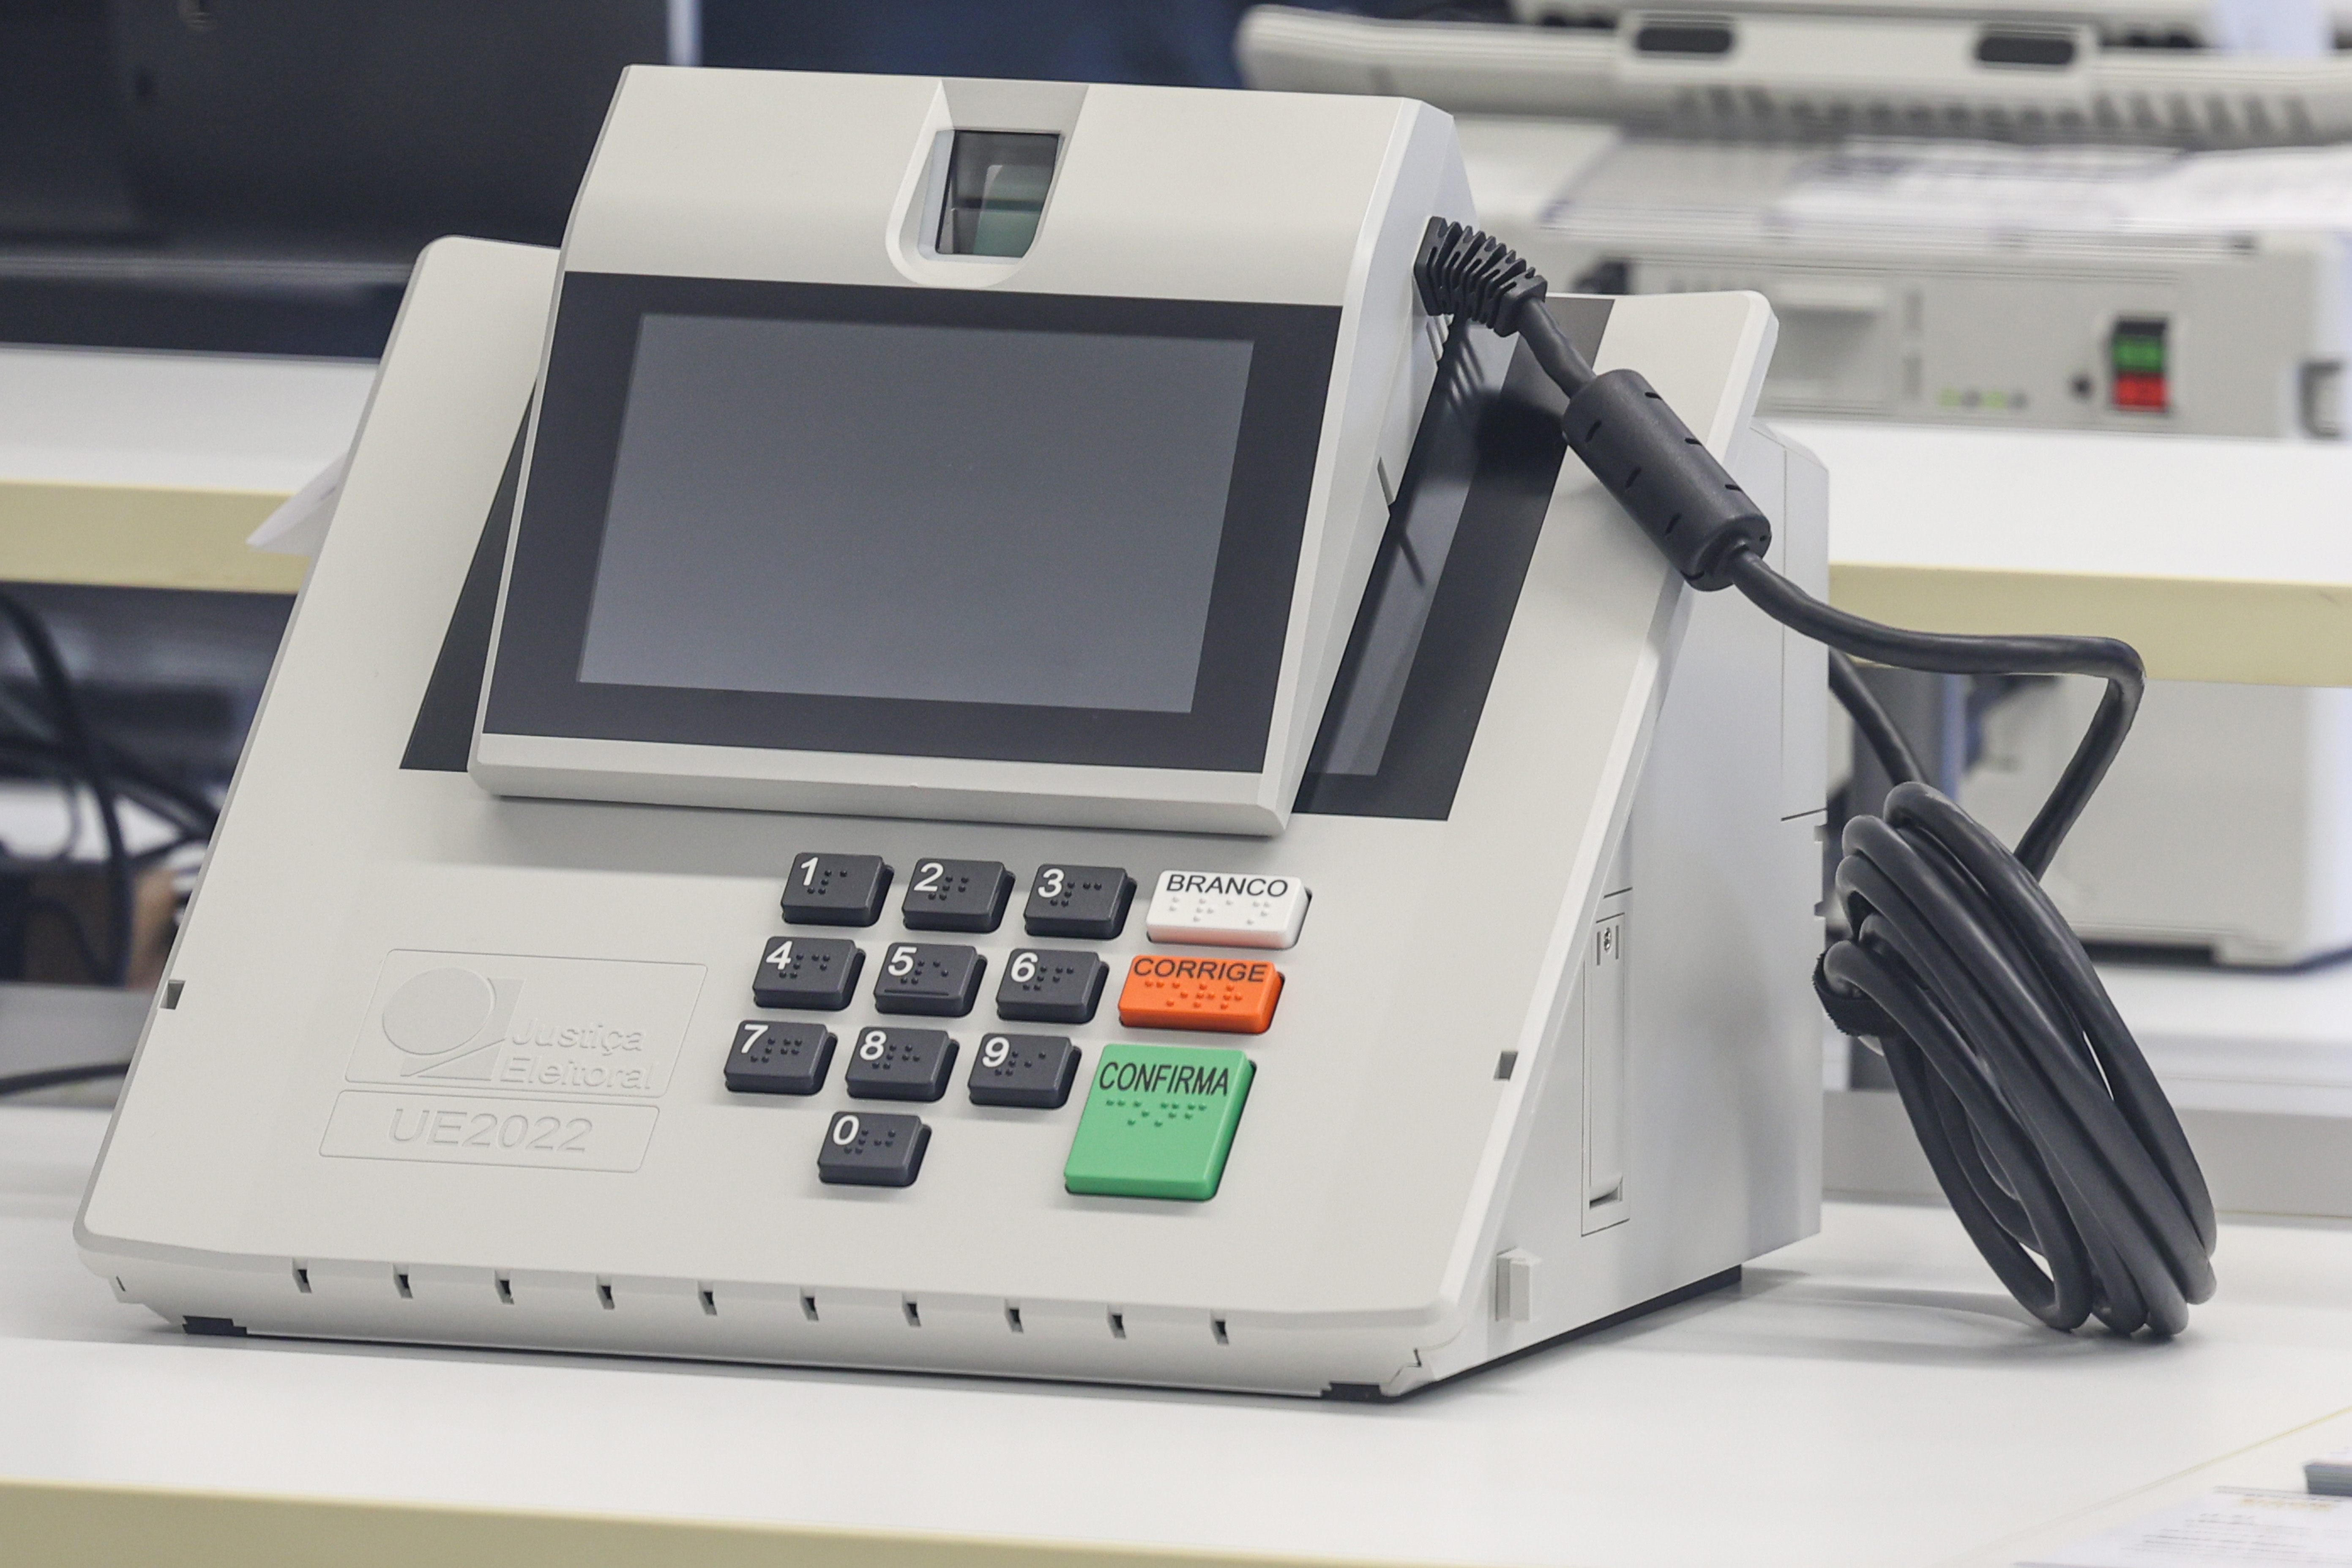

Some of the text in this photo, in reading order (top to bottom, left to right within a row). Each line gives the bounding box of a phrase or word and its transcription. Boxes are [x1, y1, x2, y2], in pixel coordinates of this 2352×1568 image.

[800, 856, 819, 886] 1
[913, 862, 944, 892] 2
[1037, 868, 1065, 899] 3
[1166, 873, 1289, 898] BRANCO
[765, 940, 793, 970] 4
[887, 945, 918, 977] 5
[1010, 951, 1039, 983] 6
[1133, 957, 1268, 983] CORRIGE
[511, 1018, 645, 1055] Justiça
[740, 1023, 769, 1054] 7
[859, 1030, 887, 1061] 8
[981, 1036, 1010, 1068] 9
[500, 1056, 659, 1089] Eleitoral
[1098, 1061, 1229, 1097] CONFIRMA
[388, 1108, 593, 1153] UE2022
[832, 1115, 860, 1146] 0
